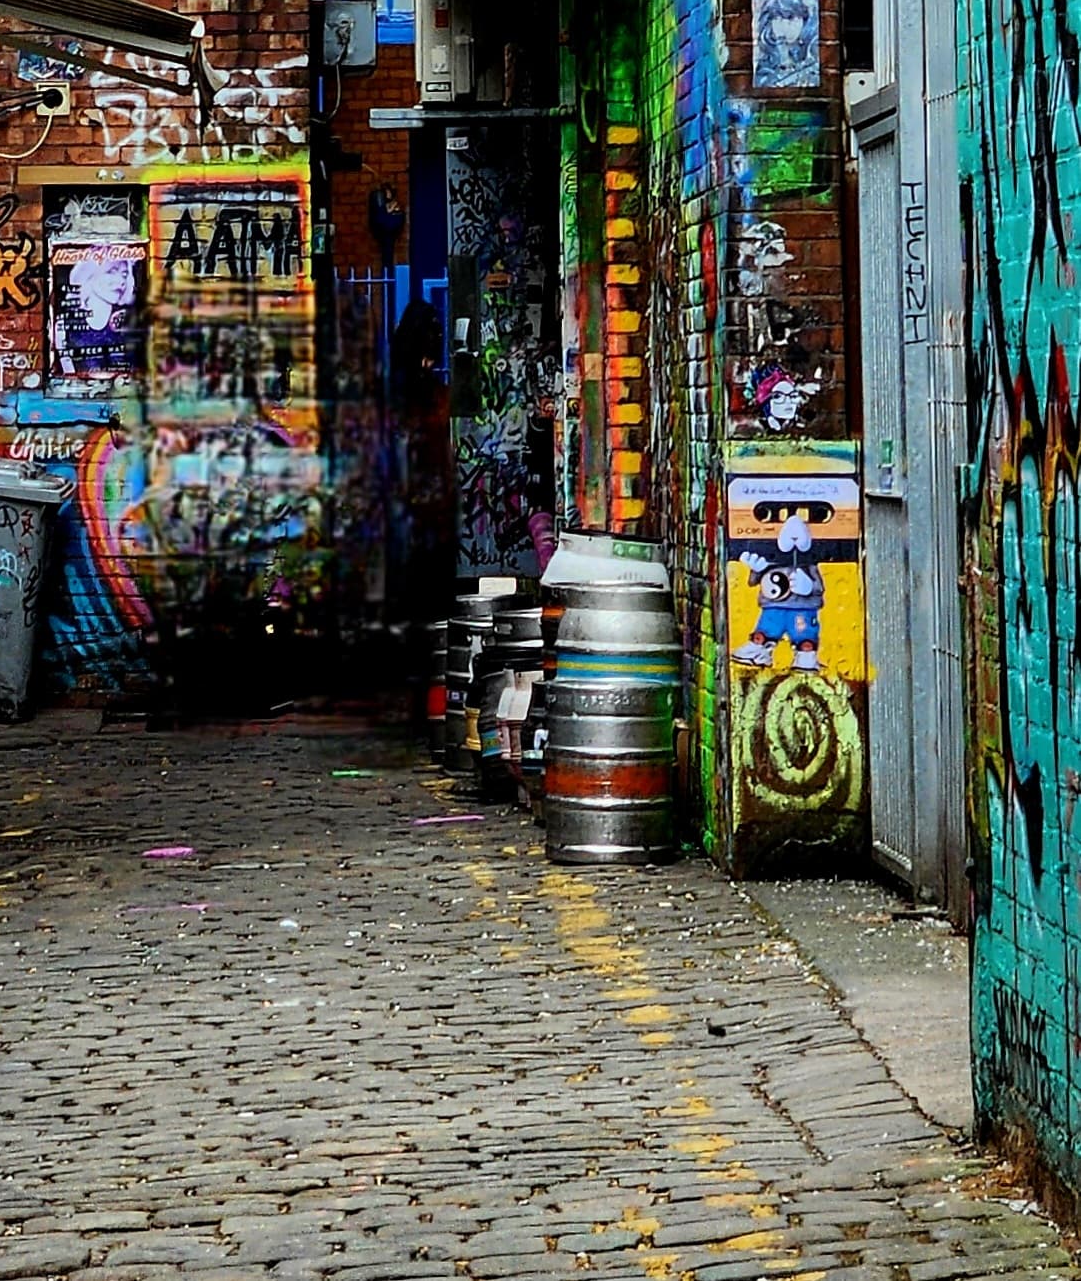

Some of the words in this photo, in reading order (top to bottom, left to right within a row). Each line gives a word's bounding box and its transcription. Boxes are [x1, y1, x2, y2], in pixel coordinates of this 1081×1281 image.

[52, 247, 91, 266] Heart
[93, 250, 107, 266] of
[108, 246, 146, 261] Glass
[9, 429, 86, 465] Charlie
